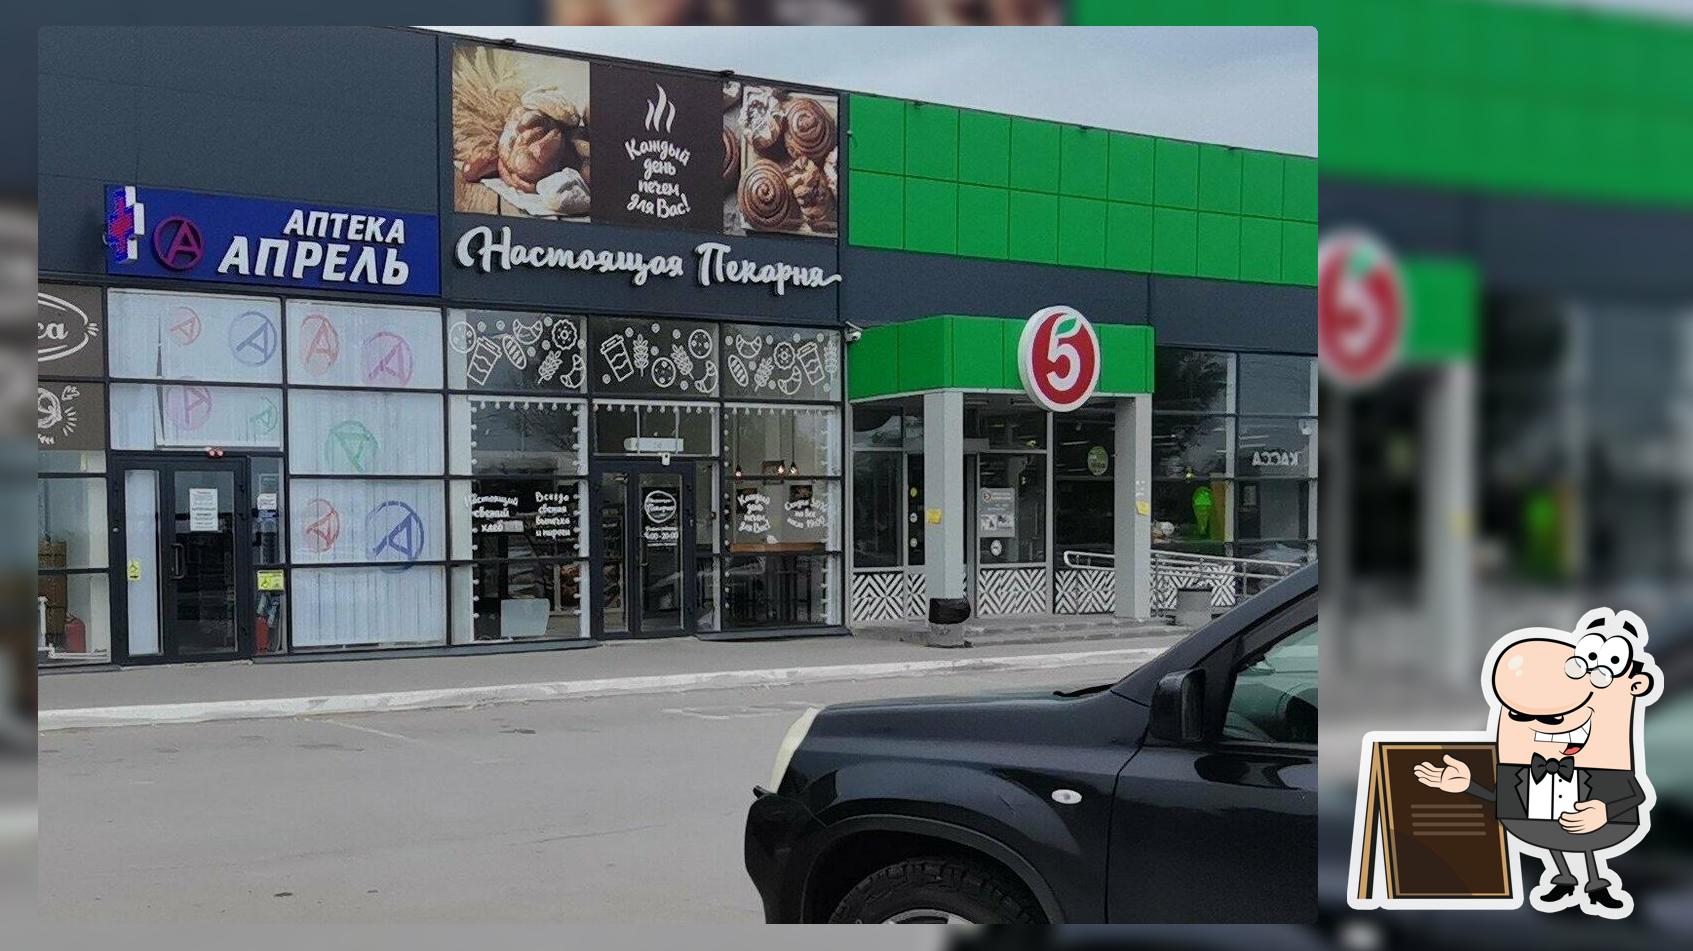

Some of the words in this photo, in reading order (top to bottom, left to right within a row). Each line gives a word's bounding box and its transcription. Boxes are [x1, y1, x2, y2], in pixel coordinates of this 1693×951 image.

[624, 137, 691, 167] Каждый
[643, 158, 676, 180] день
[638, 179, 680, 197] печем
[626, 193, 655, 215] для
[656, 193, 691, 218] Вас!
[283, 208, 406, 245] АПТЕКА
[218, 235, 410, 286] АПРЕЛЬ
[455, 225, 684, 286] Настоящая
[695, 242, 843, 296] Пекарня
